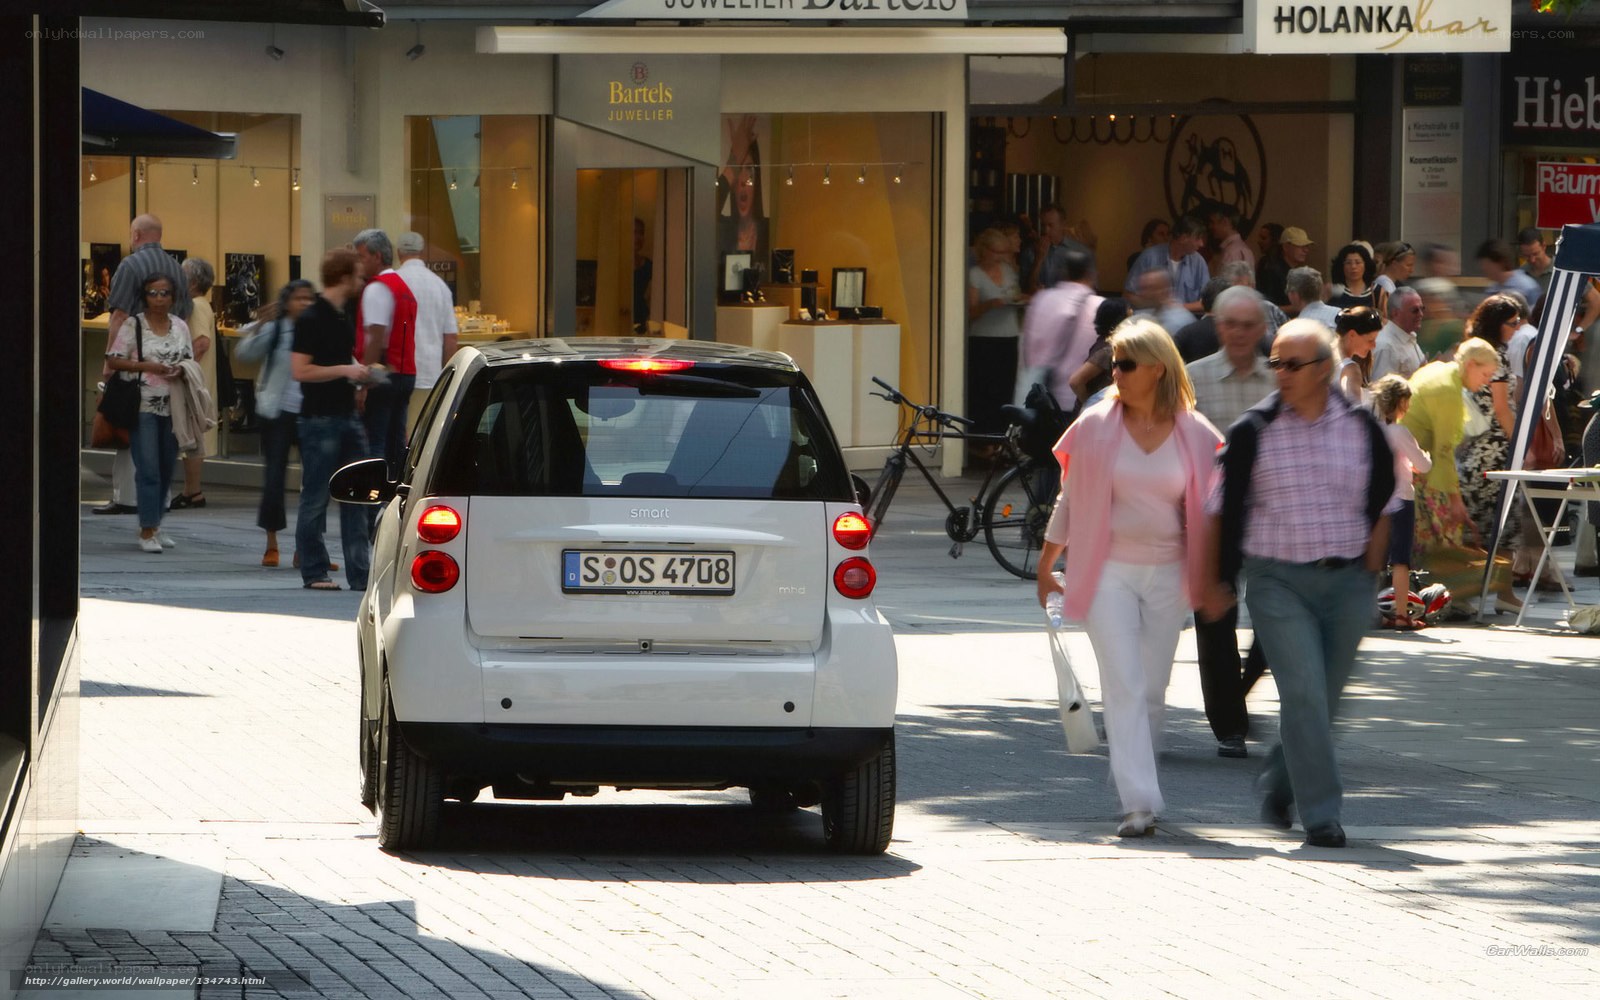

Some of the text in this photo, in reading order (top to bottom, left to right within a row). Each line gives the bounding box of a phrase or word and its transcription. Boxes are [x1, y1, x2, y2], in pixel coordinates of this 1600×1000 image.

[1273, 5, 1414, 33] HOLANKA
[608, 81, 673, 104] Bartels
[1513, 76, 1600, 129] Hieb
[607, 109, 673, 121] JUWELIER
[427, 262, 451, 271] UCCI
[630, 508, 670, 519] smart
[569, 572, 576, 581] D
[582, 556, 730, 585] S OS 4708
